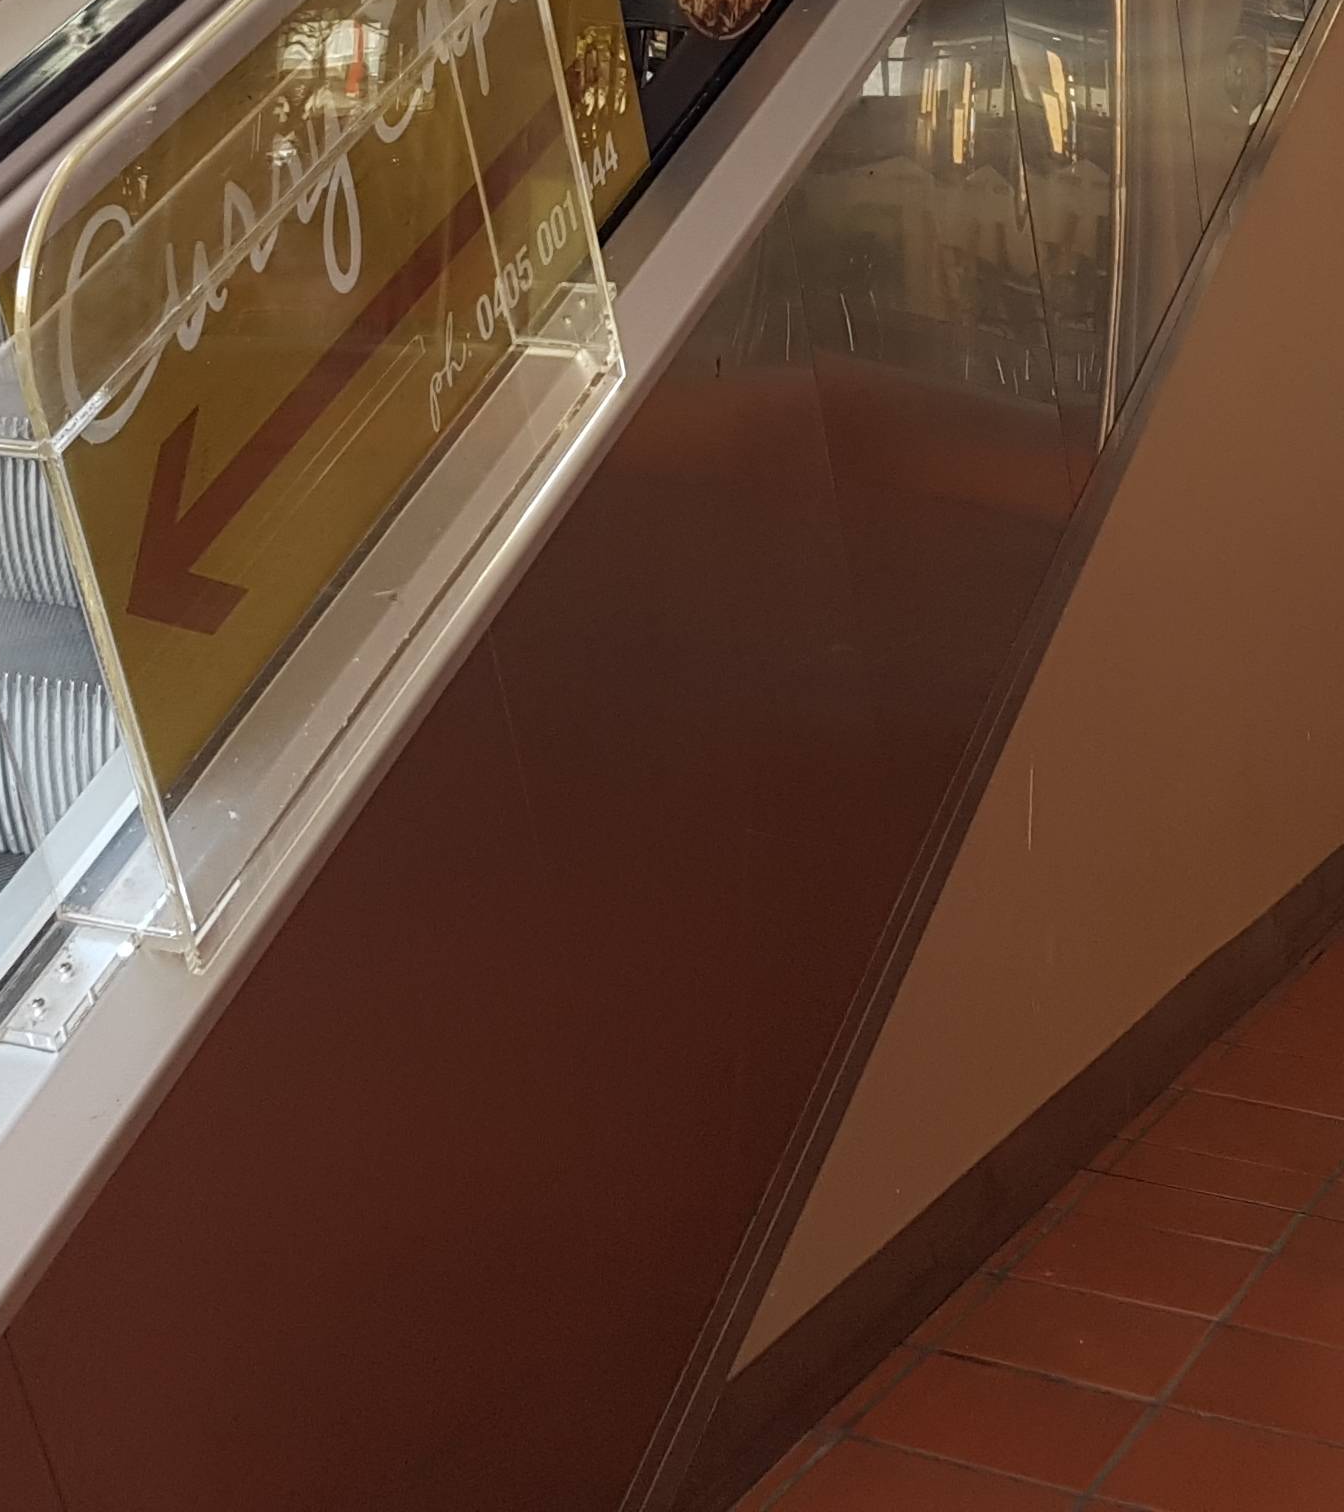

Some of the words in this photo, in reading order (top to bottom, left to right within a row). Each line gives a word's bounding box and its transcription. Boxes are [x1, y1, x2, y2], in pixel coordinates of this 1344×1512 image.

[59, 88, 374, 444] Curry
[428, 311, 470, 433] ph:
[475, 256, 536, 341] 0405
[536, 201, 581, 267] 001
